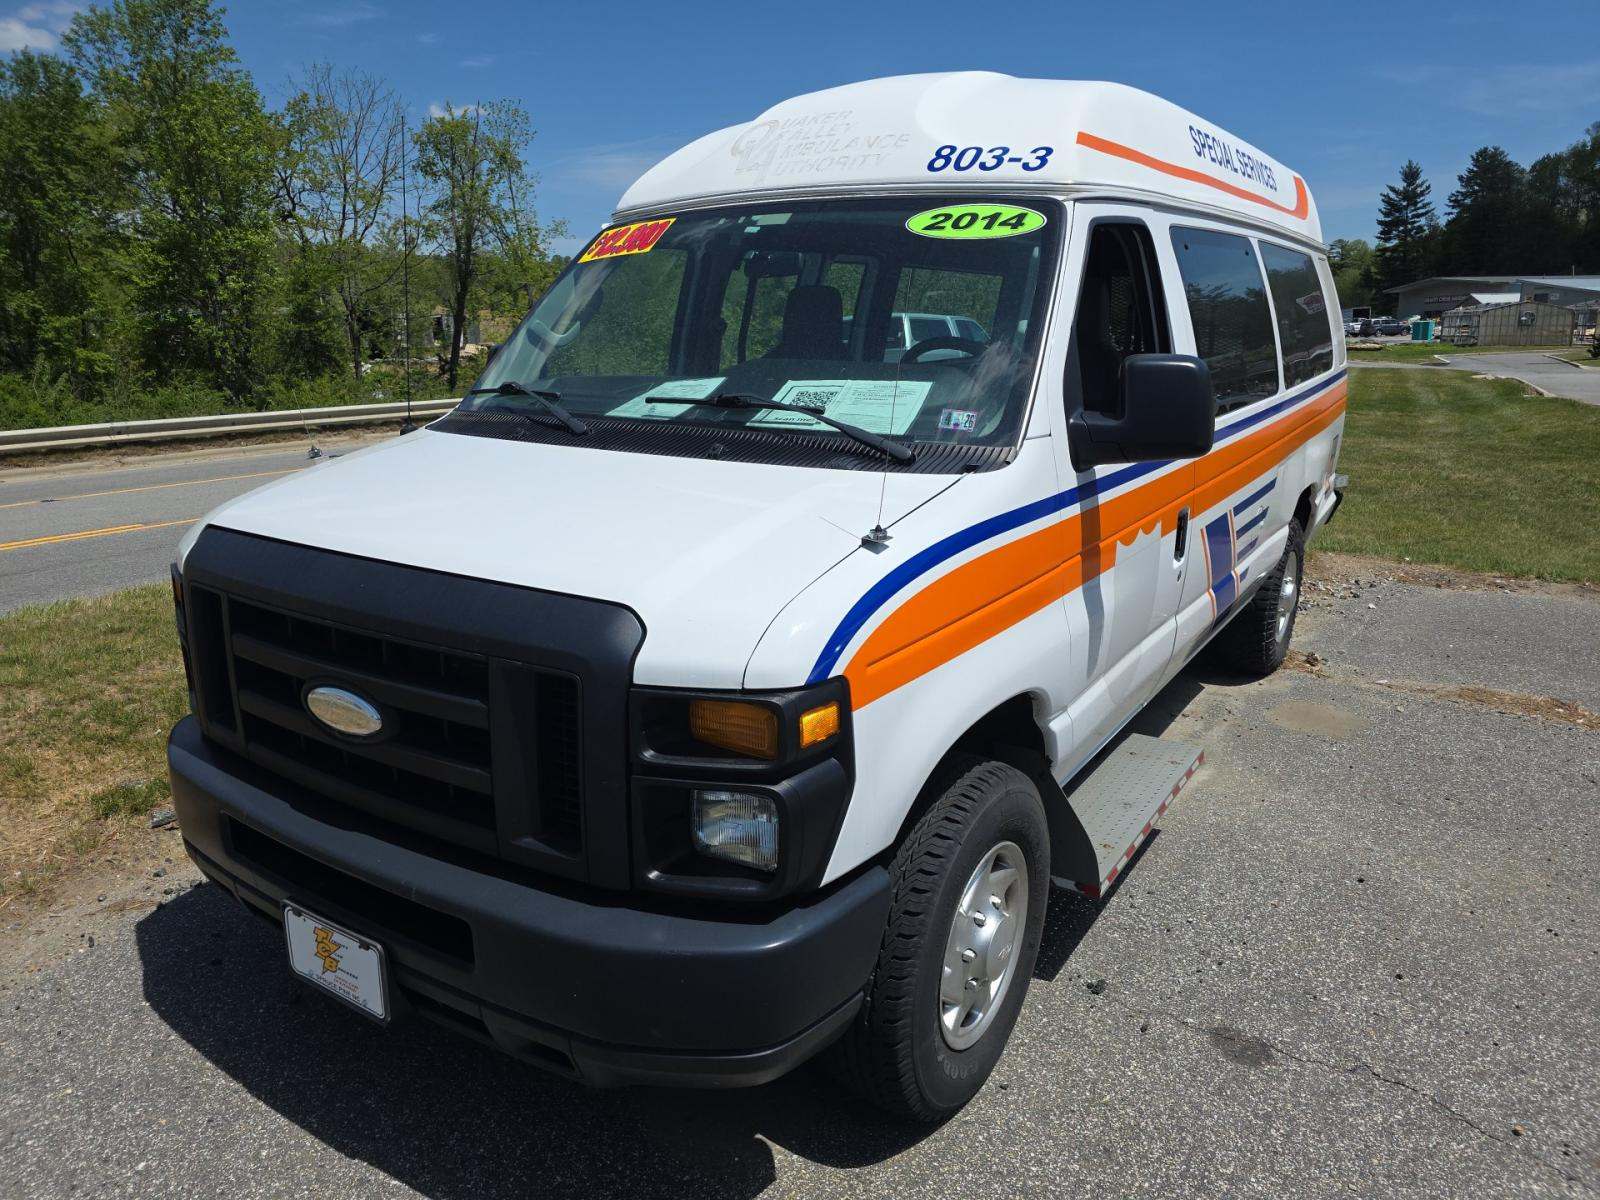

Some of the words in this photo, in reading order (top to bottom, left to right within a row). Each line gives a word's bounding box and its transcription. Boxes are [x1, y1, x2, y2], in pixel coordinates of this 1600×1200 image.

[926, 145, 1054, 172] 803-3
[1189, 125, 1238, 173] SPECIAL
[1236, 148, 1277, 192] SERVICES
[921, 212, 1029, 231] 2014
